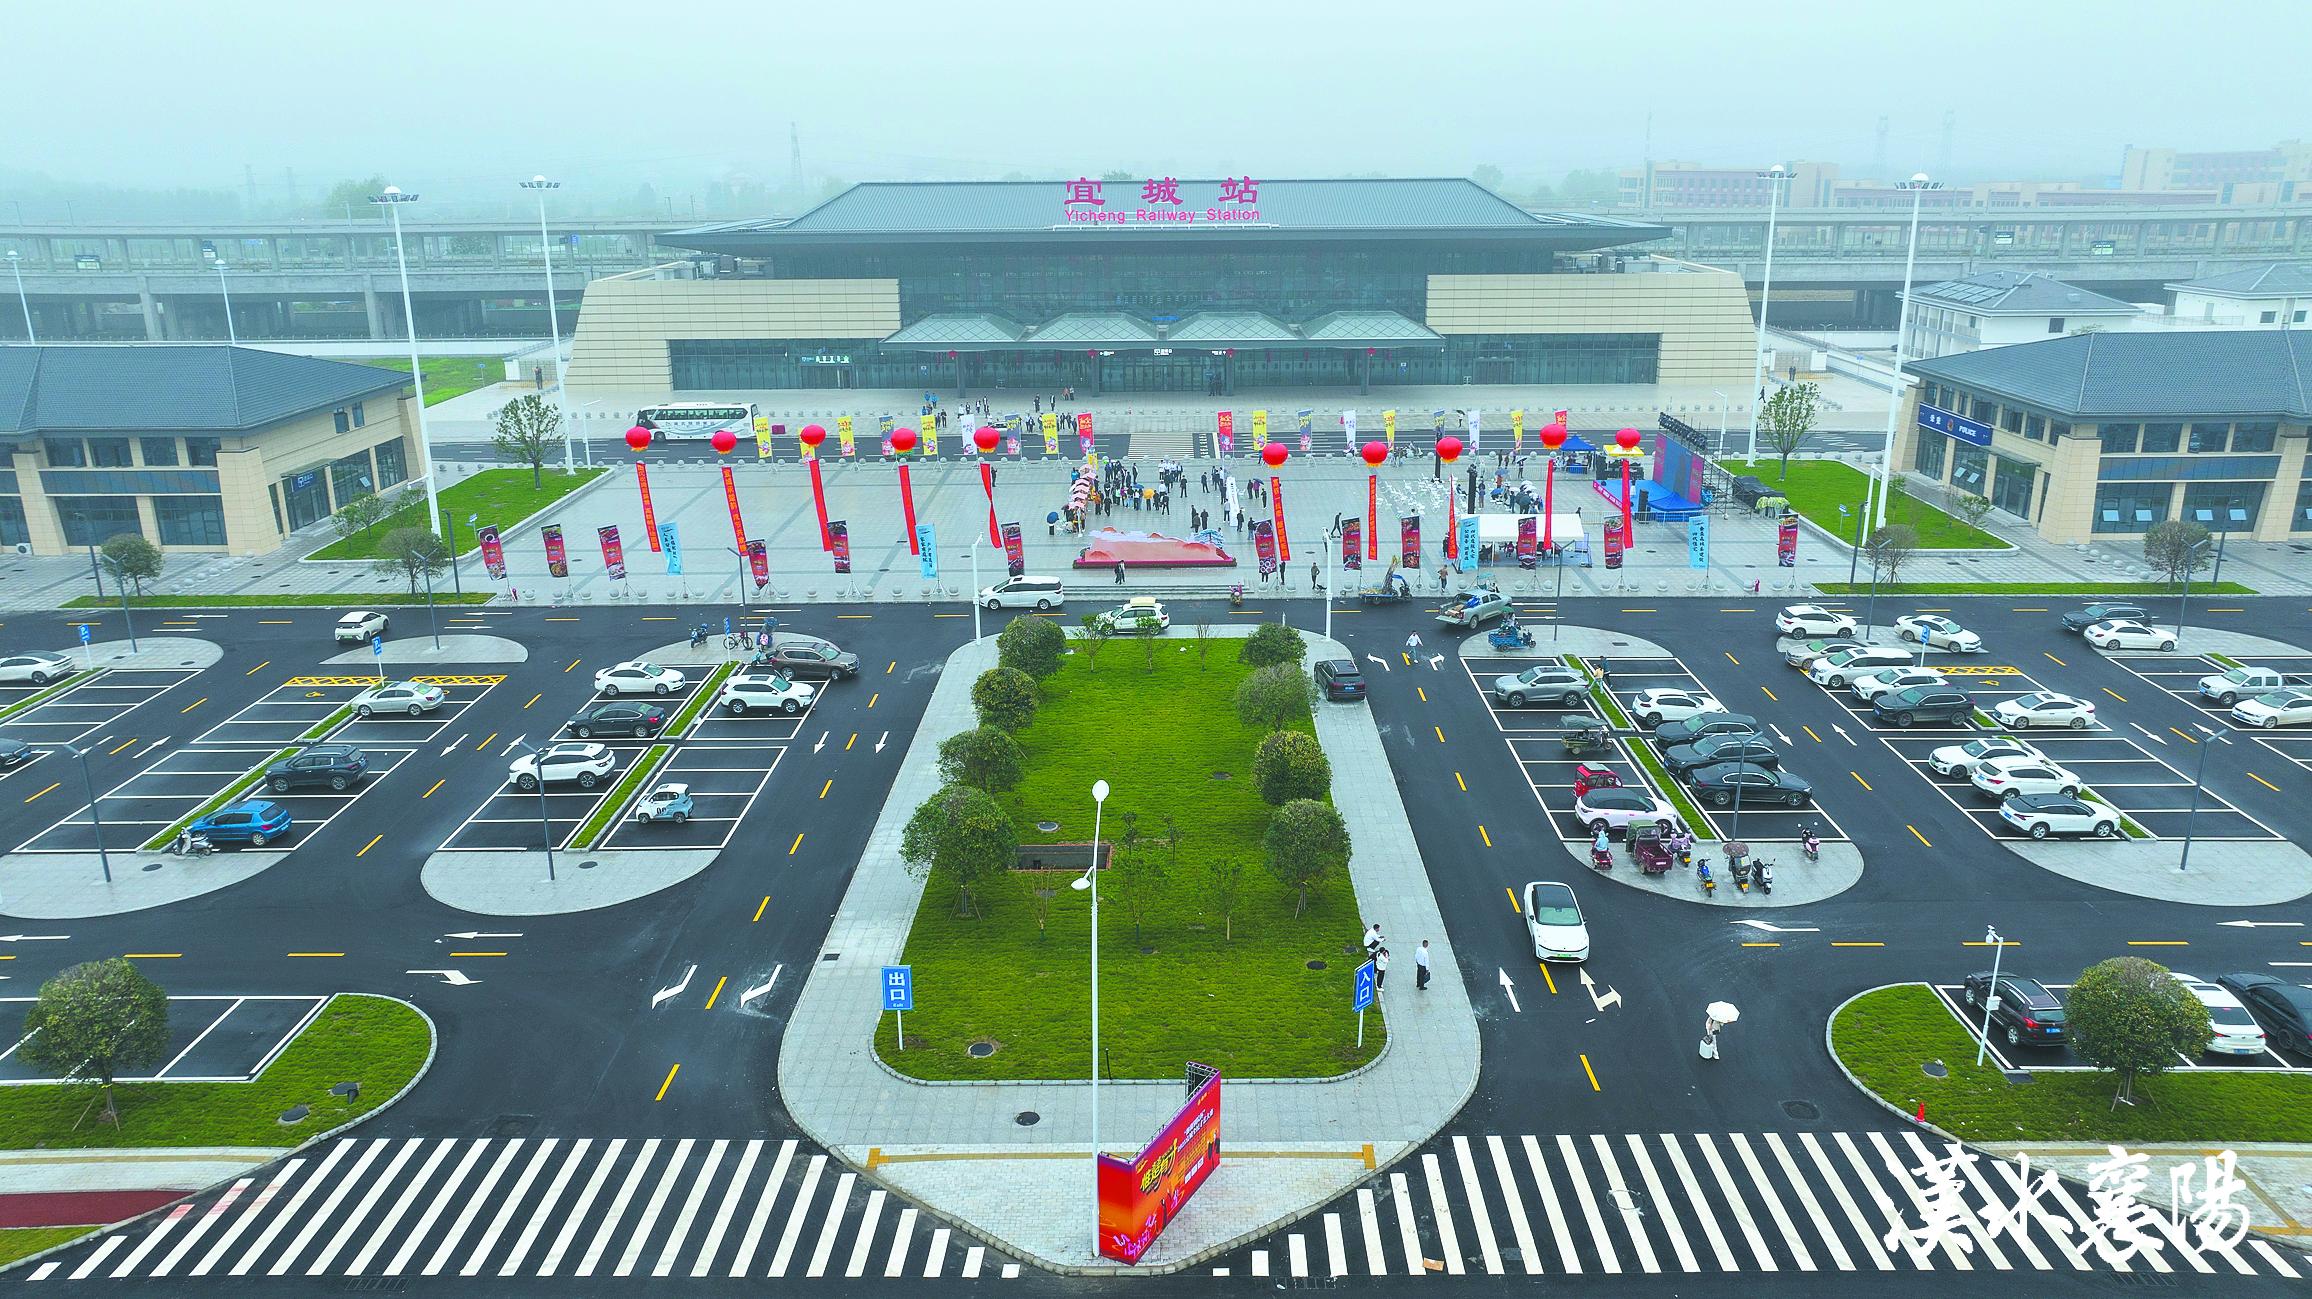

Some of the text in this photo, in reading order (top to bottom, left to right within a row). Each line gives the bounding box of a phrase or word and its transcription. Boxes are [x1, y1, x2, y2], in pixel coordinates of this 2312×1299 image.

[1064, 177, 1260, 205] 宜城站
[1065, 208, 1260, 224] Yicheng Railway Station
[1958, 425, 1977, 437] POLICE
[888, 971, 905, 1001] 出口
[1360, 971, 1371, 1002] 入口
